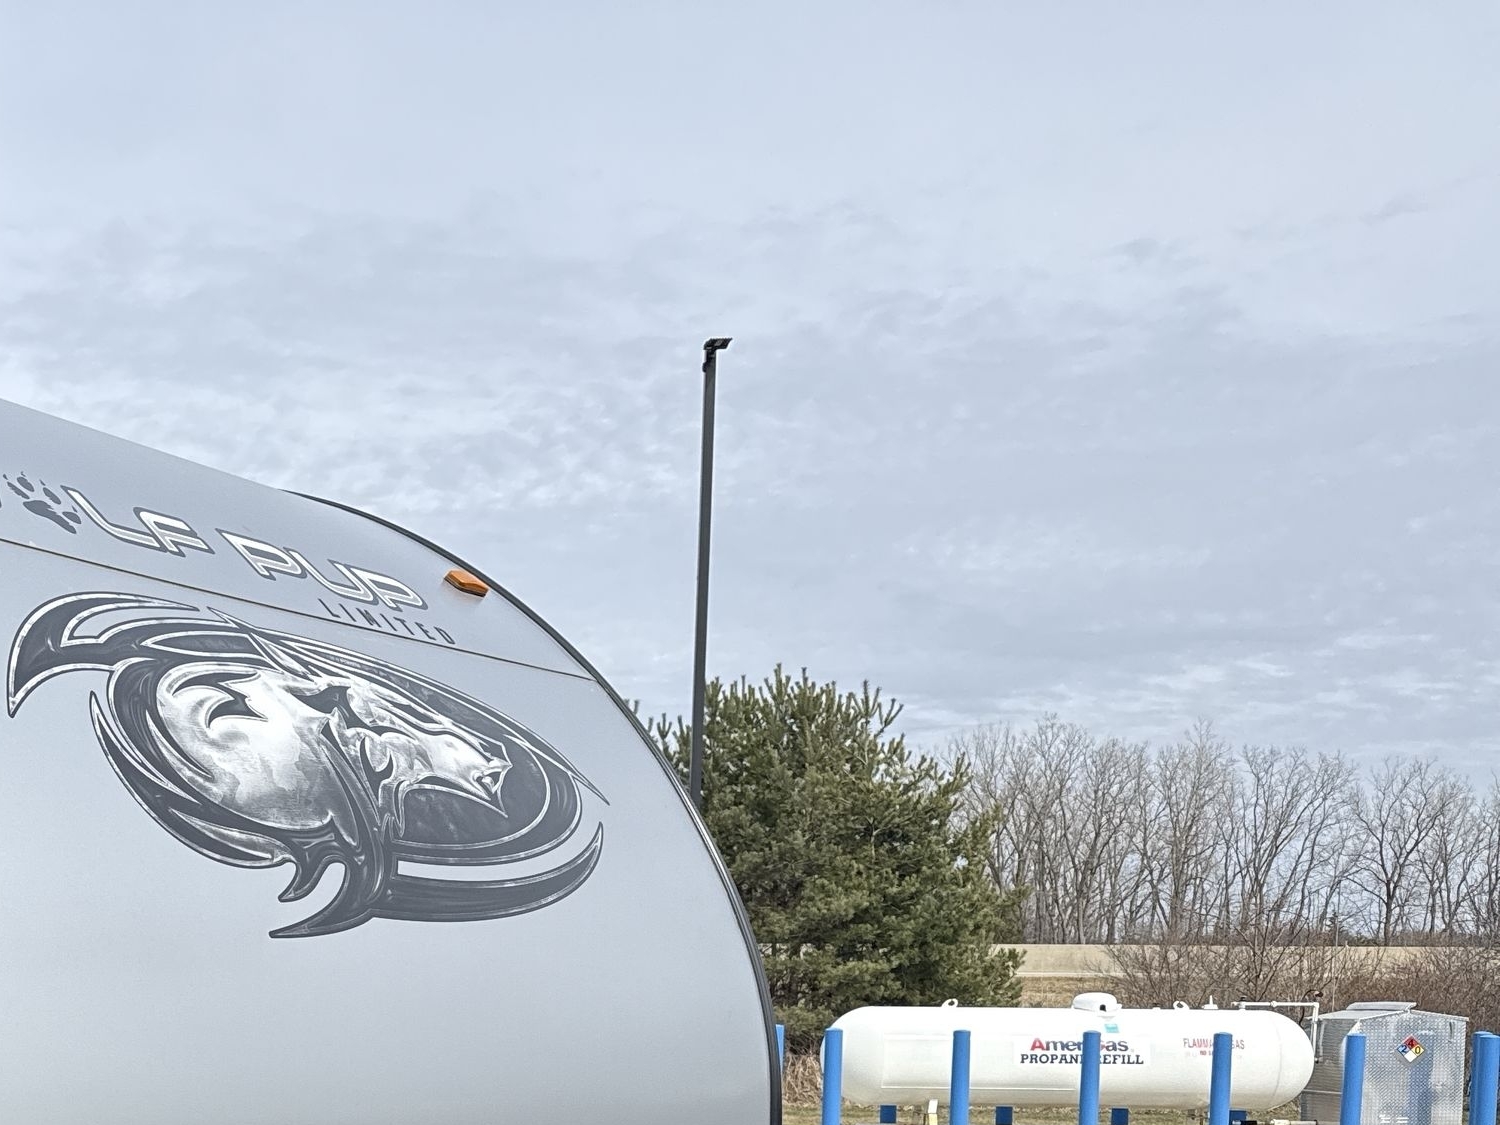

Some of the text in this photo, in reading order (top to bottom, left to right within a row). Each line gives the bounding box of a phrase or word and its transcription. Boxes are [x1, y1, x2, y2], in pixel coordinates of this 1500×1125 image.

[216, 529, 428, 612] PUP
[318, 598, 456, 645] LIMITED
[1030, 1038, 1129, 1052] Ameras
[1408, 1039, 1415, 1047] 4
[1401, 1045, 1421, 1055] 2 0
[1020, 1053, 1145, 1065] PROPAN EFILL
